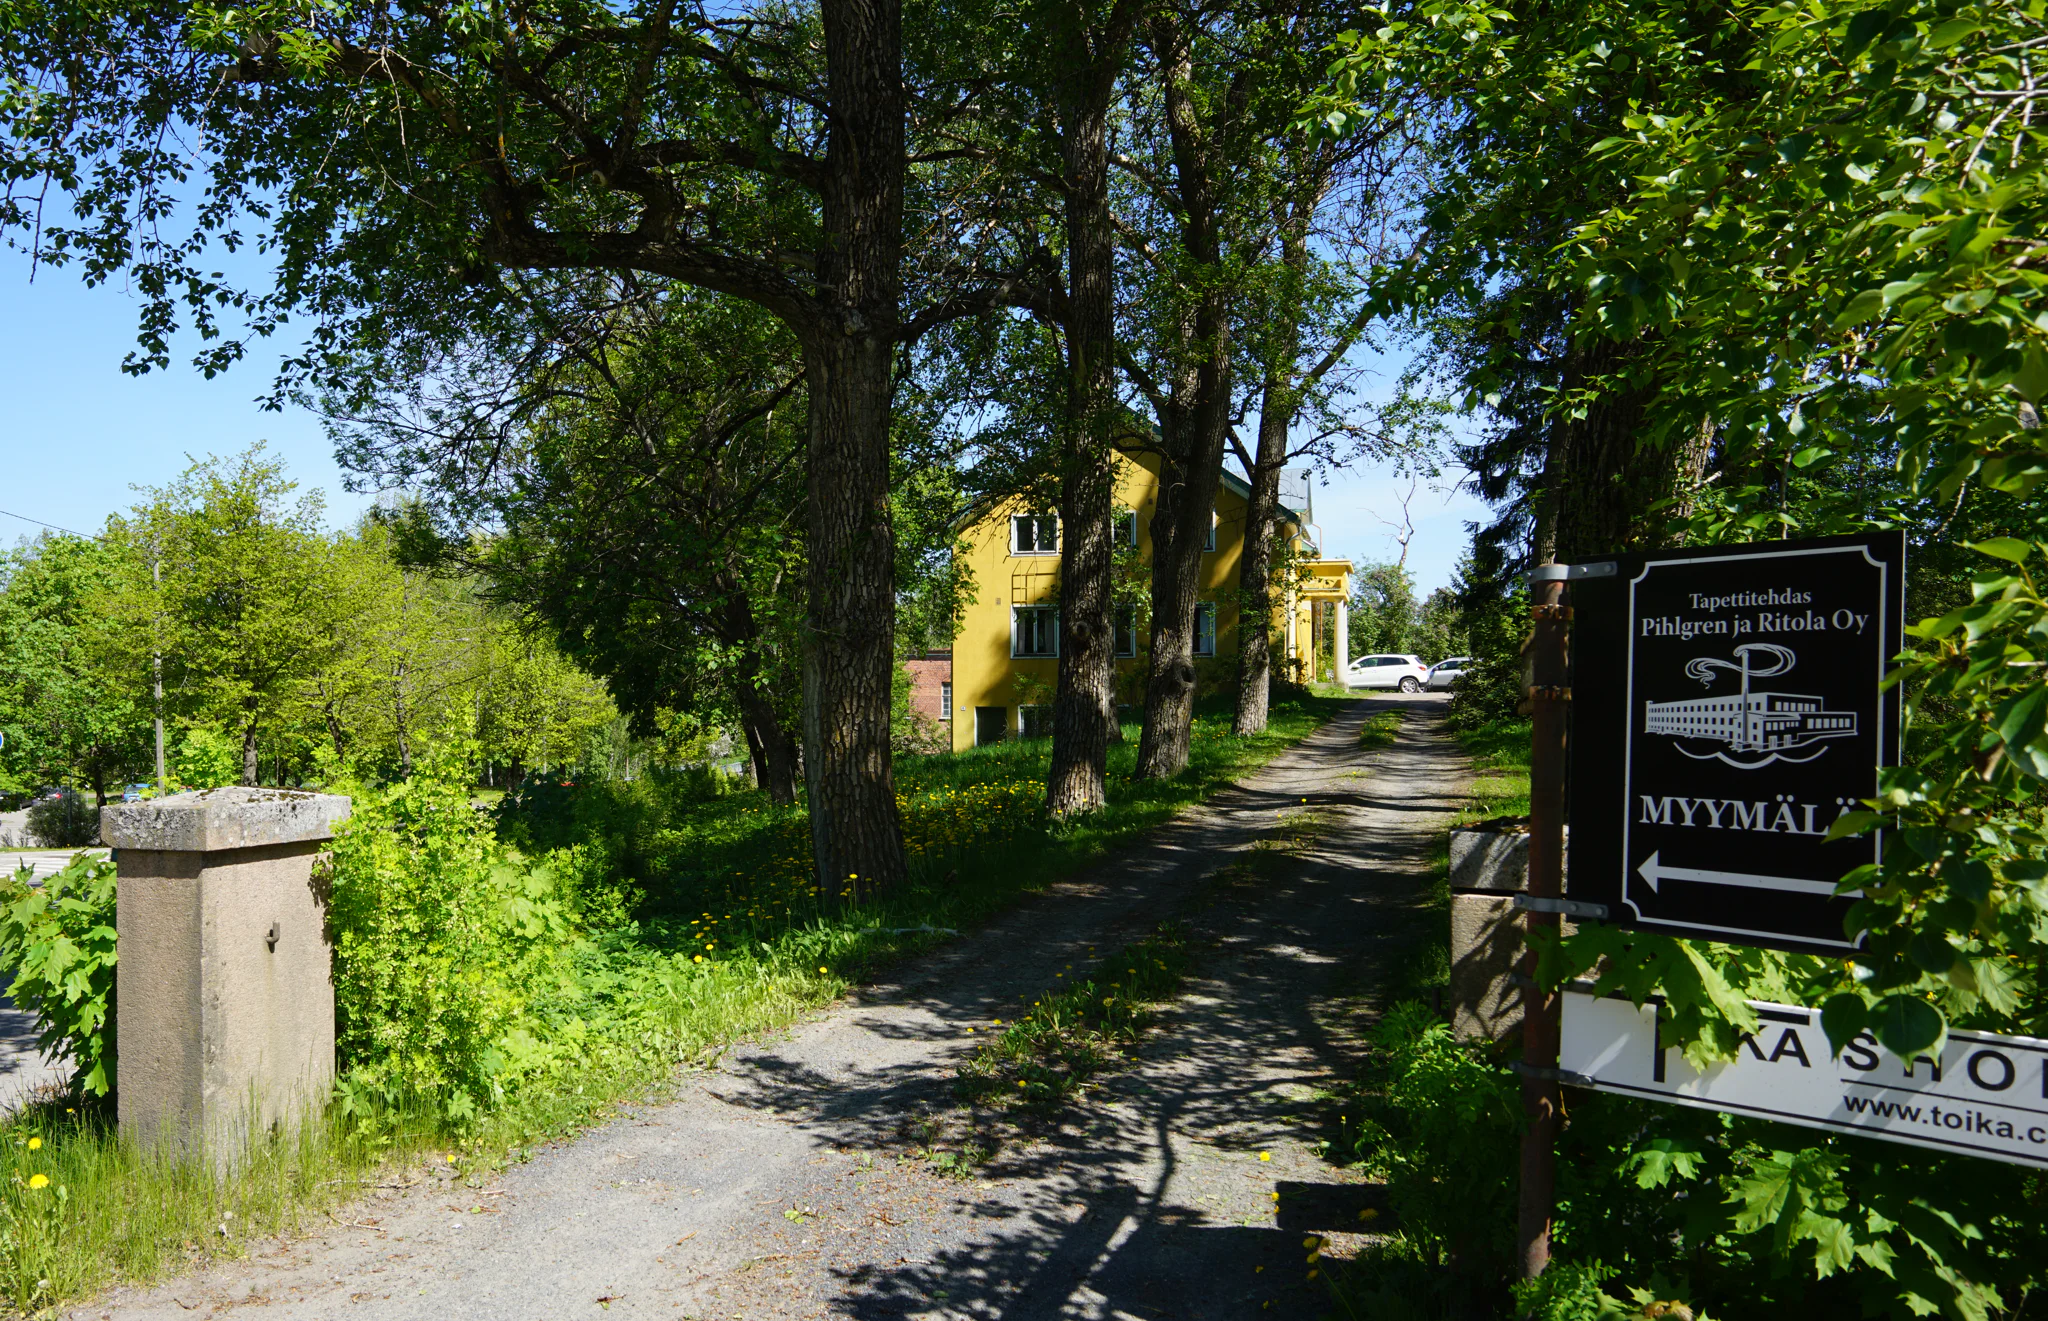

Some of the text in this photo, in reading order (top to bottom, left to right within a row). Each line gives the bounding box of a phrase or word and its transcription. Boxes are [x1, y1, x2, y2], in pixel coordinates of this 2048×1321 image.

[1689, 588, 1811, 612] Tapettitehdas
[1641, 609, 1869, 640] Pihlgren ja Ritola Oy
[1843, 1032, 2048, 1099] SHO
